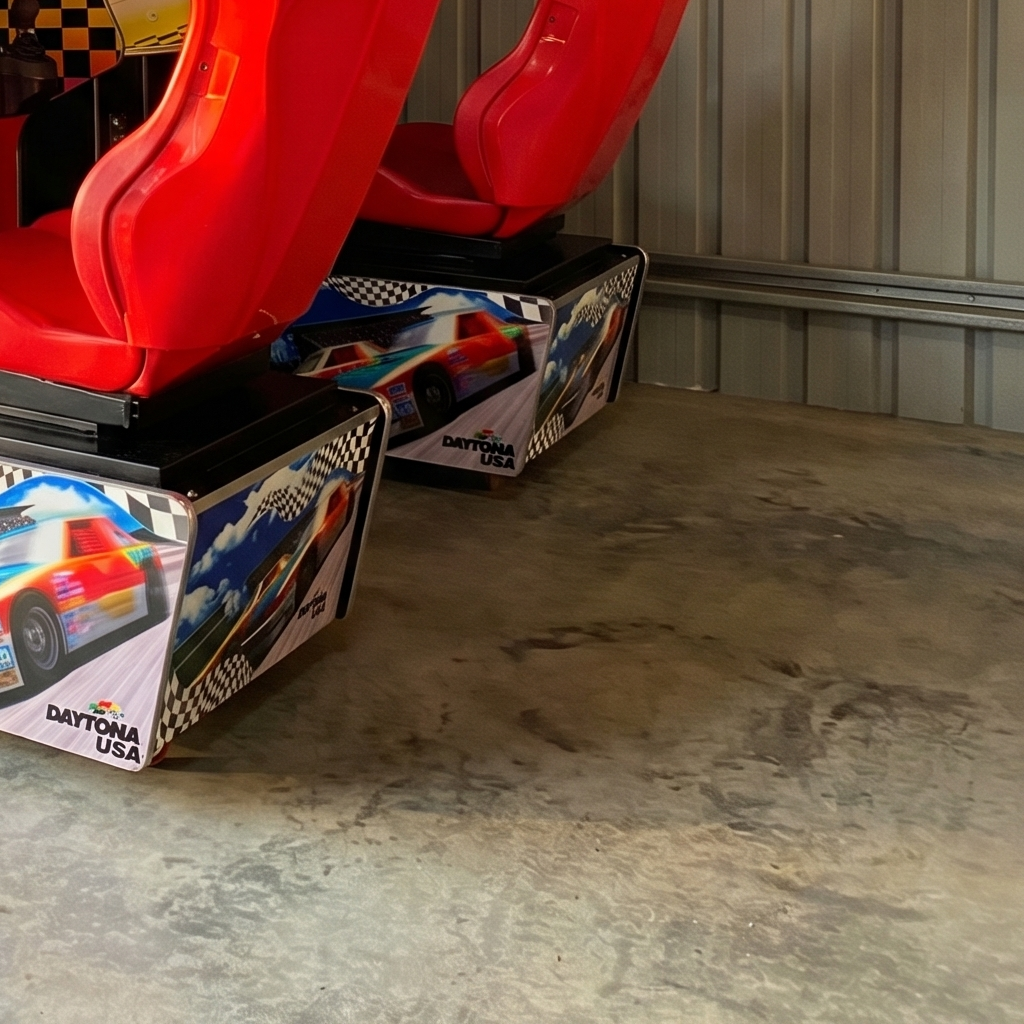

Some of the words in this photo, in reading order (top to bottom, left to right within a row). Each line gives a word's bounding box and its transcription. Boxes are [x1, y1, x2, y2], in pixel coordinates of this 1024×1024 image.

[442, 435, 515, 457] DAYTONA
[480, 454, 515, 470] USA
[46, 703, 140, 745] DAYTONA
[95, 736, 140, 764] USA
